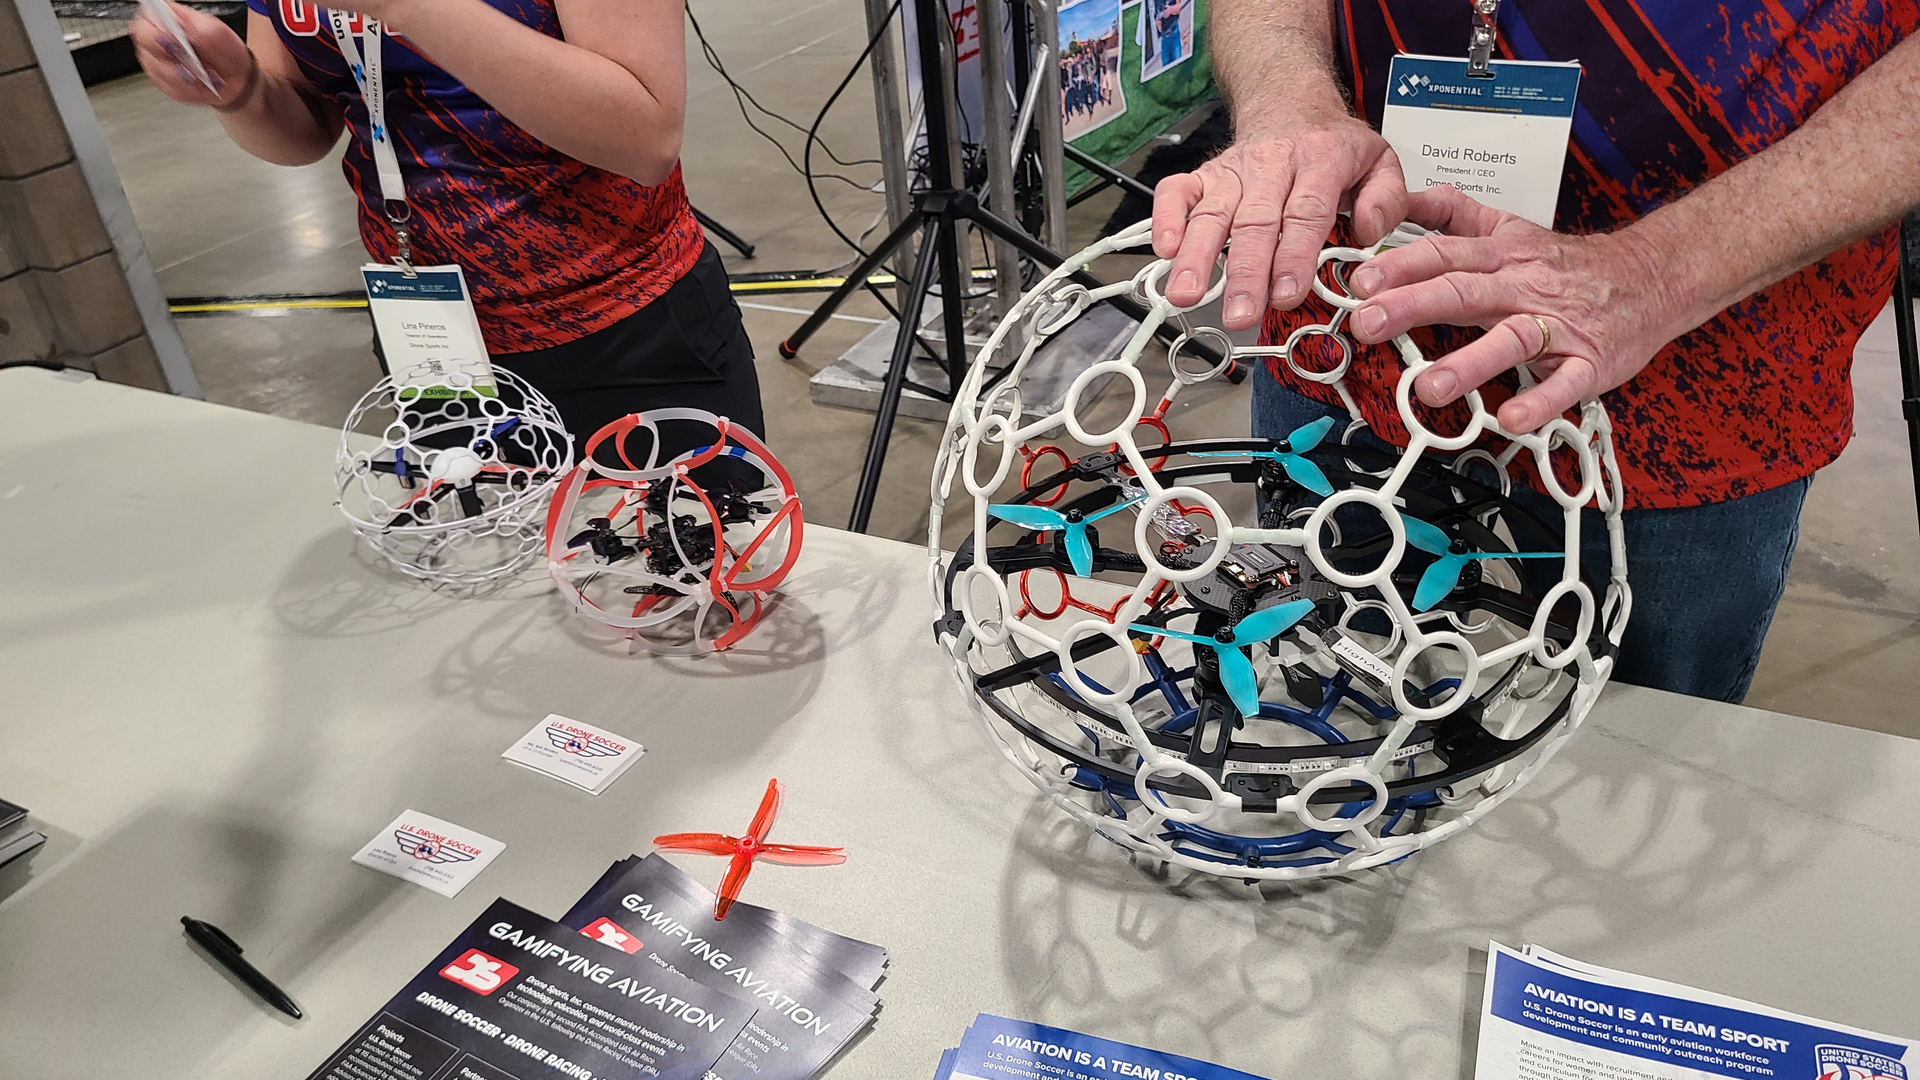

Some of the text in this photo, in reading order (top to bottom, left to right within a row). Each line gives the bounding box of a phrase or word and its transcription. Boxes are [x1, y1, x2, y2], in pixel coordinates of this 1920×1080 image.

[1428, 84, 1482, 96] XPONENTIAL
[1422, 144, 1517, 165] David Roberts
[1436, 165, 1471, 176] President
[1477, 169, 1495, 178] CEO
[1455, 182, 1483, 192] Sports
[1486, 185, 1502, 194] Inc.
[402, 322, 446, 331] Lina Pineros
[550, 721, 627, 752] U.S. DRONE SOCCER
[400, 824, 482, 857] U.S. DRONE SOCCER
[621, 893, 831, 1036] GAMIFYING AVIATION
[648, 952, 668, 968] Drone
[488, 922, 725, 1033] GAMIFYING AVIATION
[507, 991, 520, 1002] Our
[517, 995, 542, 1014] company
[546, 1007, 557, 1018] the
[556, 1013, 577, 1028] second
[618, 1042, 633, 1055] UAS
[629, 1048, 642, 1058] Air
[638, 1051, 656, 1065] Race
[516, 983, 667, 1056] technology, education, and world-class events
[526, 975, 686, 1052] Drone Sports, Inc. convenes market leadership in
[1523, 982, 1790, 1054] AVIATION IS A TEAM SPORT
[377, 1024, 405, 1044] Projects
[415, 991, 592, 1080] DRONE SOCCER DRONE RACING
[499, 996, 526, 1015] Organizer
[530, 1010, 540, 1020] the
[575, 1033, 586, 1043] the
[585, 1036, 602, 1051] Drone
[602, 1046, 621, 1061] Racing
[621, 1054, 644, 1070] League
[747, 1020, 782, 1047] leadership
[780, 1043, 789, 1052] in
[747, 1035, 770, 1053] events
[1522, 1010, 1774, 1077] development and community outreach program
[1523, 1000, 1770, 1065] U.S. Drone Soccer is an early aviation workforce
[379, 1039, 395, 1051] Drone
[394, 1046, 412, 1060] Soccer
[727, 1049, 747, 1063] eague
[992, 1034, 1072, 1061] AVIATION
[1074, 1051, 1092, 1065] IS
[1092, 1057, 1106, 1070] A
[1111, 1059, 1160, 1080] TEAM
[1519, 1048, 1551, 1063] careers
[1552, 1058, 1564, 1066] for
[1565, 1062, 1596, 1076] women
[1598, 1070, 1615, 1080] and
[1520, 1039, 1543, 1051] Make
[1544, 1047, 1555, 1055] an
[1556, 1050, 1585, 1065] impact
[1586, 1058, 1604, 1068] with
[1605, 1064, 1655, 1080] recruitment
[1821, 1049, 1902, 1071] UNITED STATES
[983, 1061, 1040, 1080] development
[987, 1051, 1004, 1061] U.S.
[1006, 1055, 1033, 1067] Drone
[1034, 1061, 1065, 1075] Soccer
[1066, 1069, 1074, 1078] is
[1518, 1064, 1551, 1080] through
[1519, 1056, 1535, 1067] and
[1536, 1061, 1580, 1080] curriculum
[1821, 1056, 1903, 1077] DRONE SOCCER
